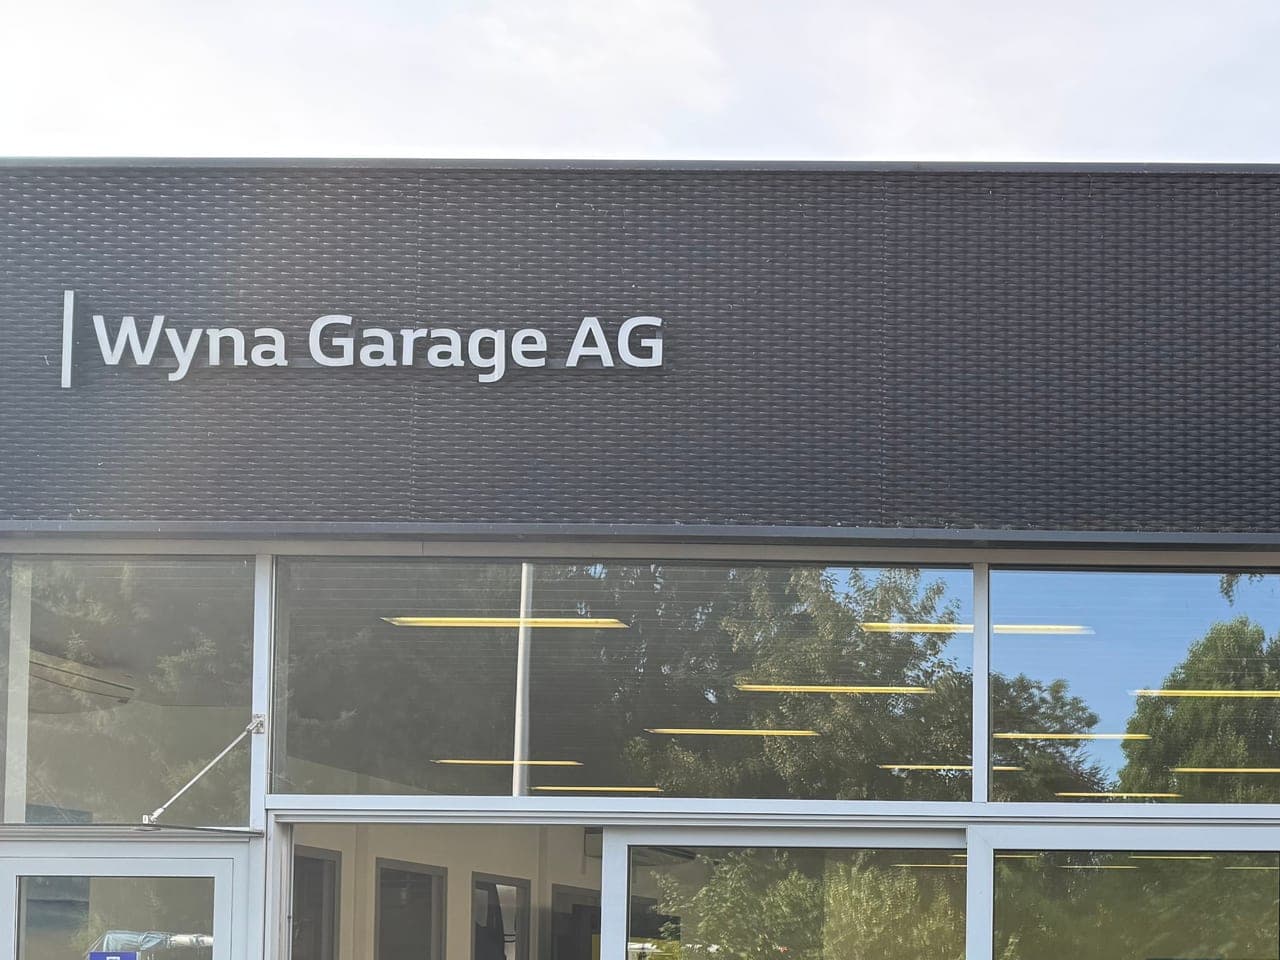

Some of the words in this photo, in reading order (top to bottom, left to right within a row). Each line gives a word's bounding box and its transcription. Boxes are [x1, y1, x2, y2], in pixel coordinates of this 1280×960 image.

[92, 314, 289, 383] Wyna
[307, 313, 549, 384] Garage
[564, 315, 665, 369] AG
